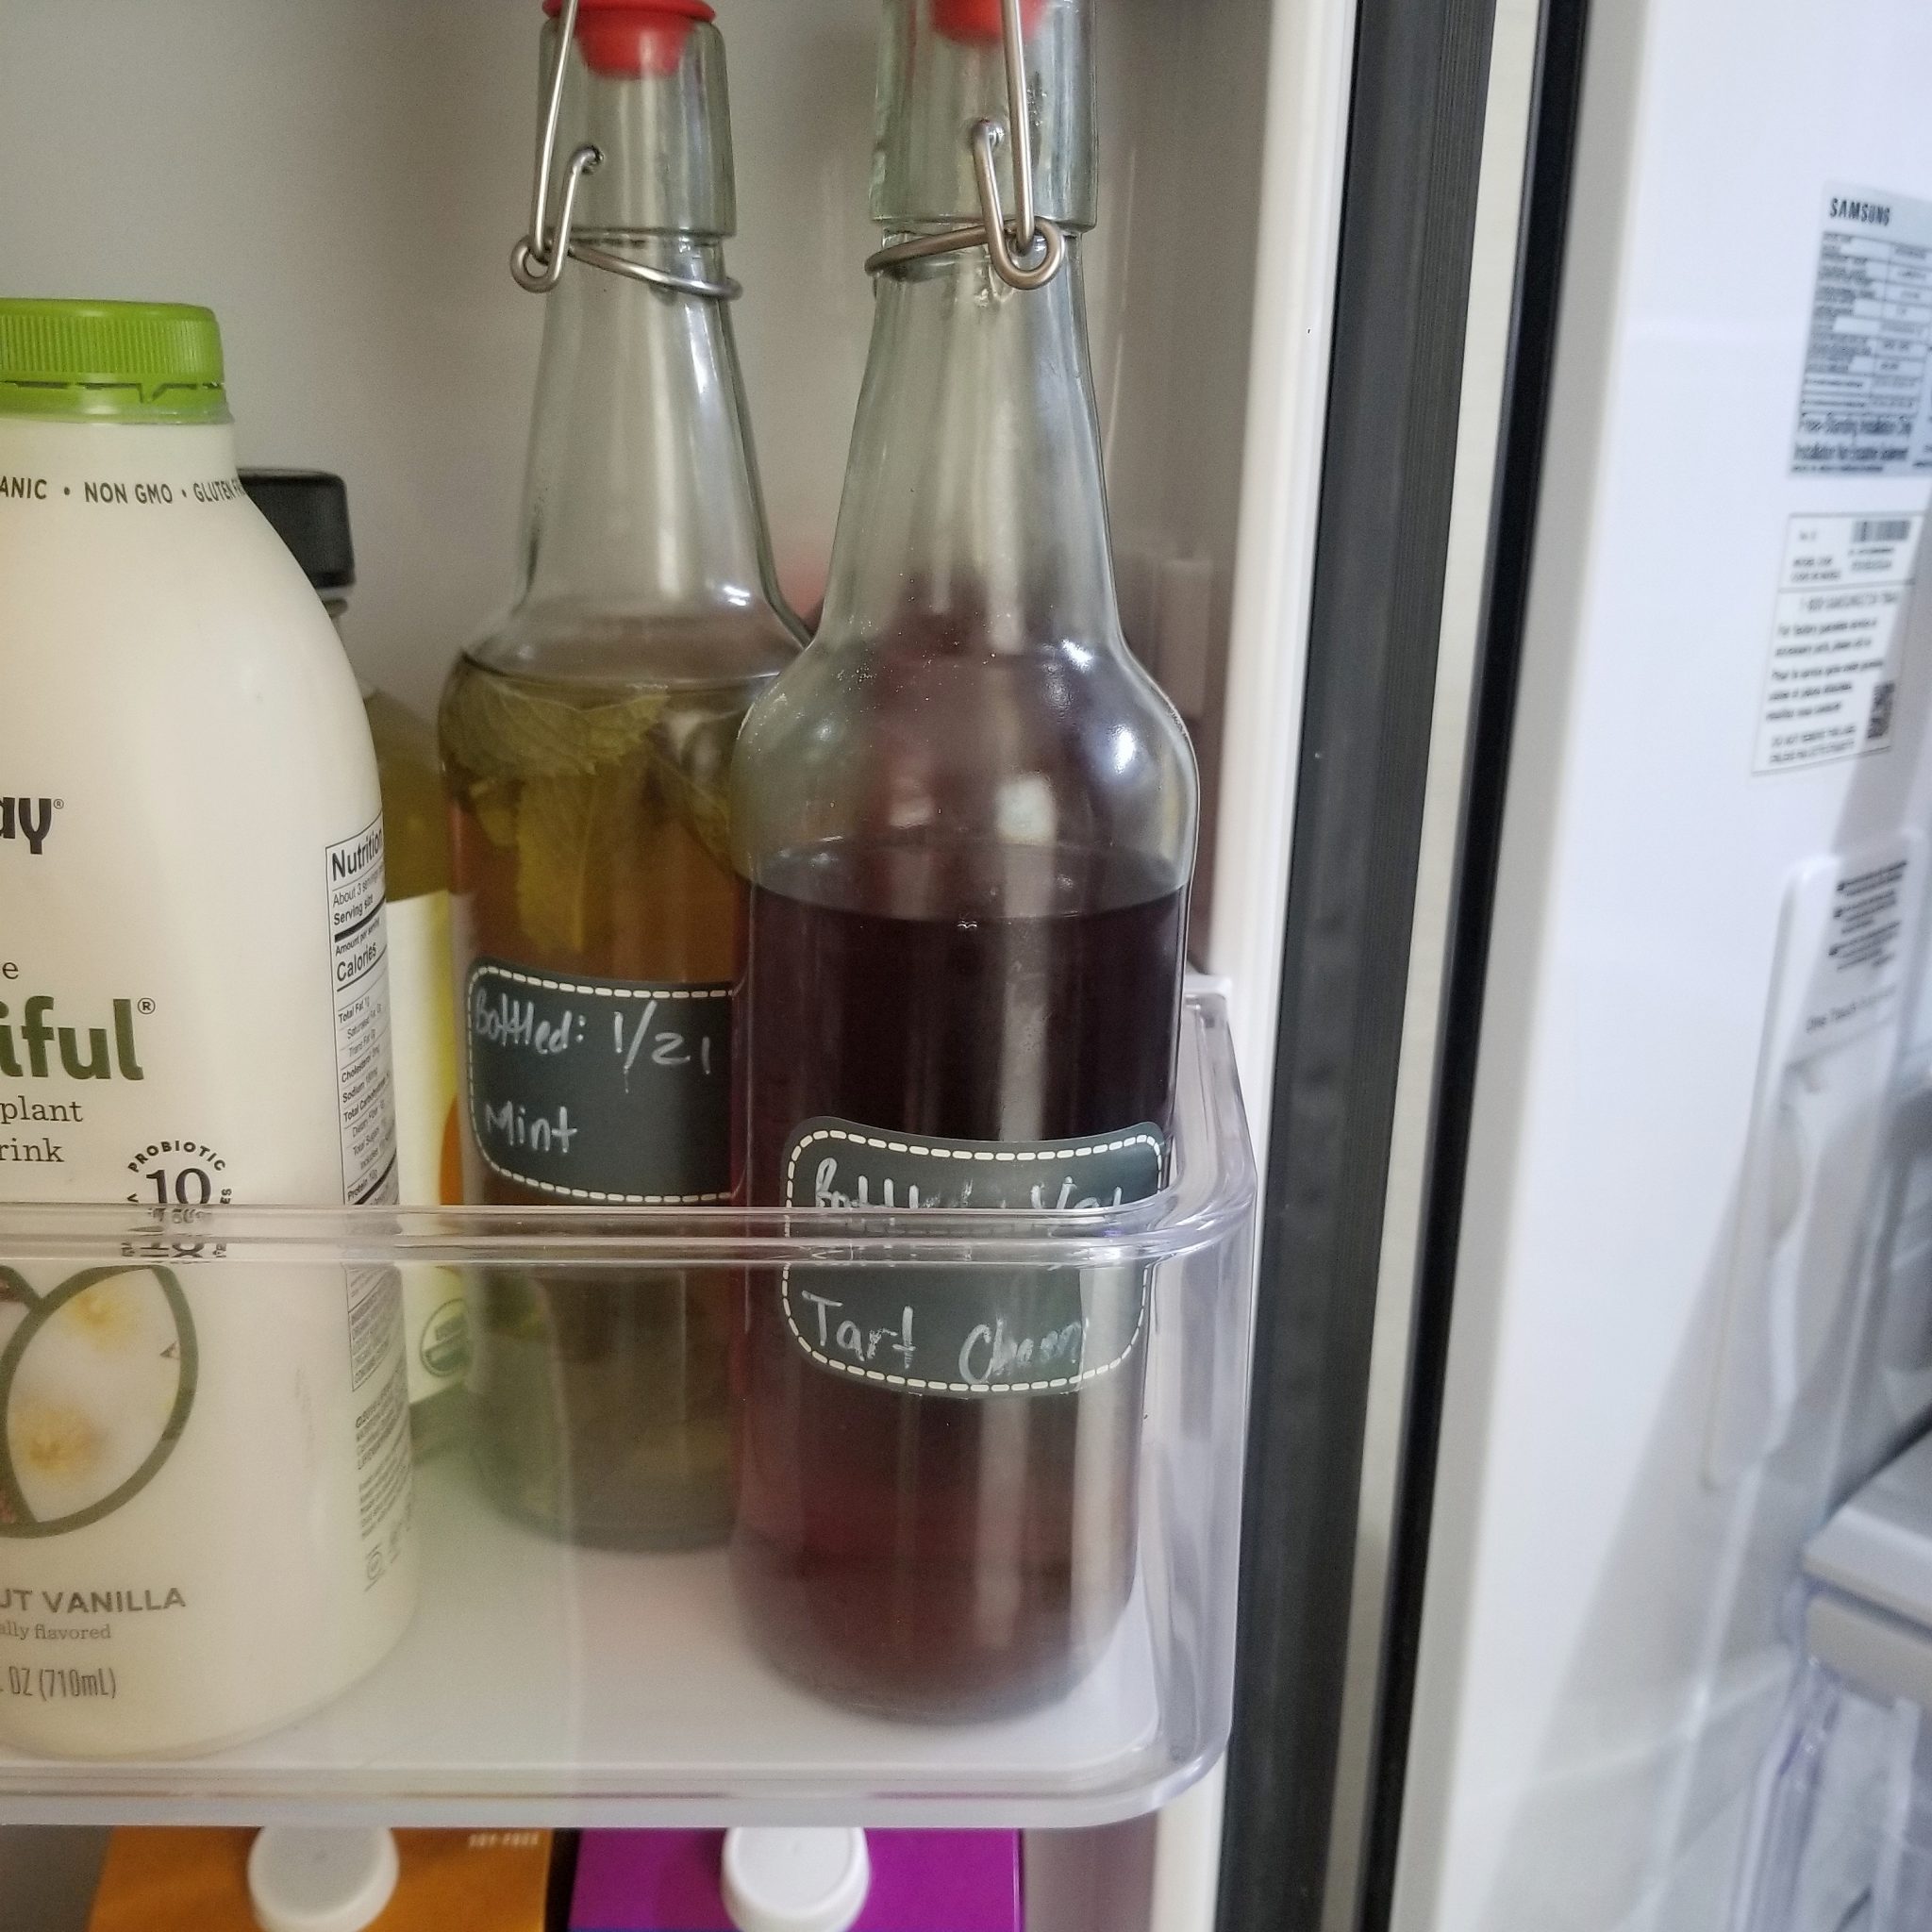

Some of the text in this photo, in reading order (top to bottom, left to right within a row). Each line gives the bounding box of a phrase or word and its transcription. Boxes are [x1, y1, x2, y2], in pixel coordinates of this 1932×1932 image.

[1830, 197, 1890, 226] SAMSUNG
[84, 481, 127, 504] NON
[134, 483, 173, 504] GMO
[333, 887, 356, 906] About
[334, 903, 363, 925] Serving
[336, 937, 359, 957] Amount
[337, 942, 377, 982] Calories
[0, 1095, 83, 1124] plant
[485, 1100, 577, 1153] Mint
[127, 1140, 226, 1174] PROBIOTIC
[801, 1290, 916, 1370] Tart
[42, 1587, 186, 1614] VANILLA
[34, 1623, 111, 1640] flavored
[8, 1665, 116, 1702] OZ (710mL)
